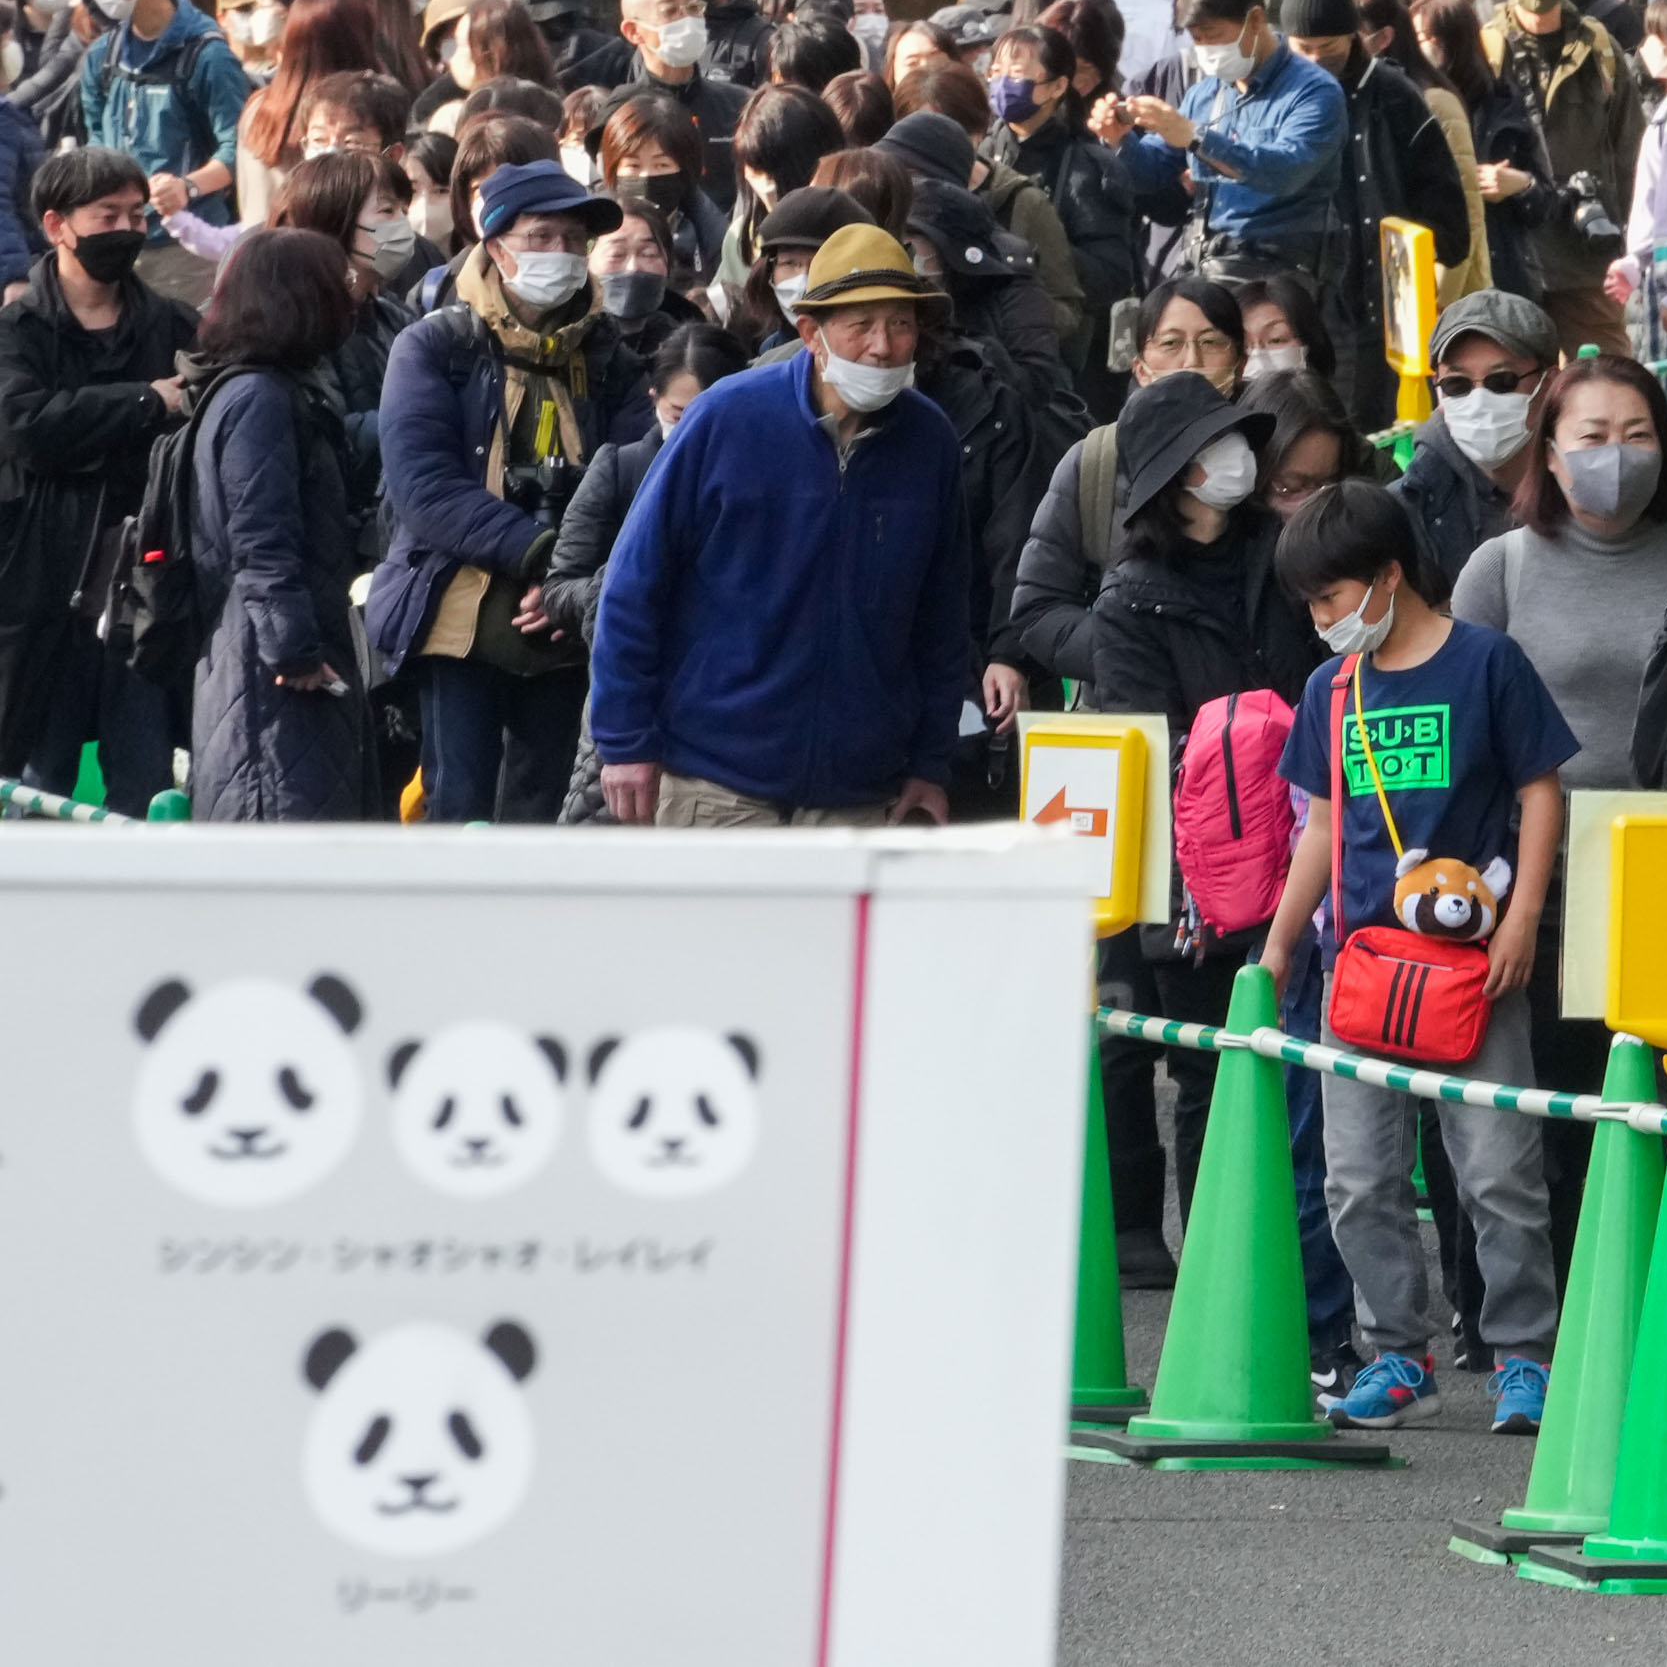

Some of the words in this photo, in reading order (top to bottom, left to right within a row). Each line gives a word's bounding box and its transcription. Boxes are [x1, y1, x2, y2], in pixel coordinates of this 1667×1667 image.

[1352, 752, 1436, 782] TOT
[335, 1574, 476, 1615] リーリー
